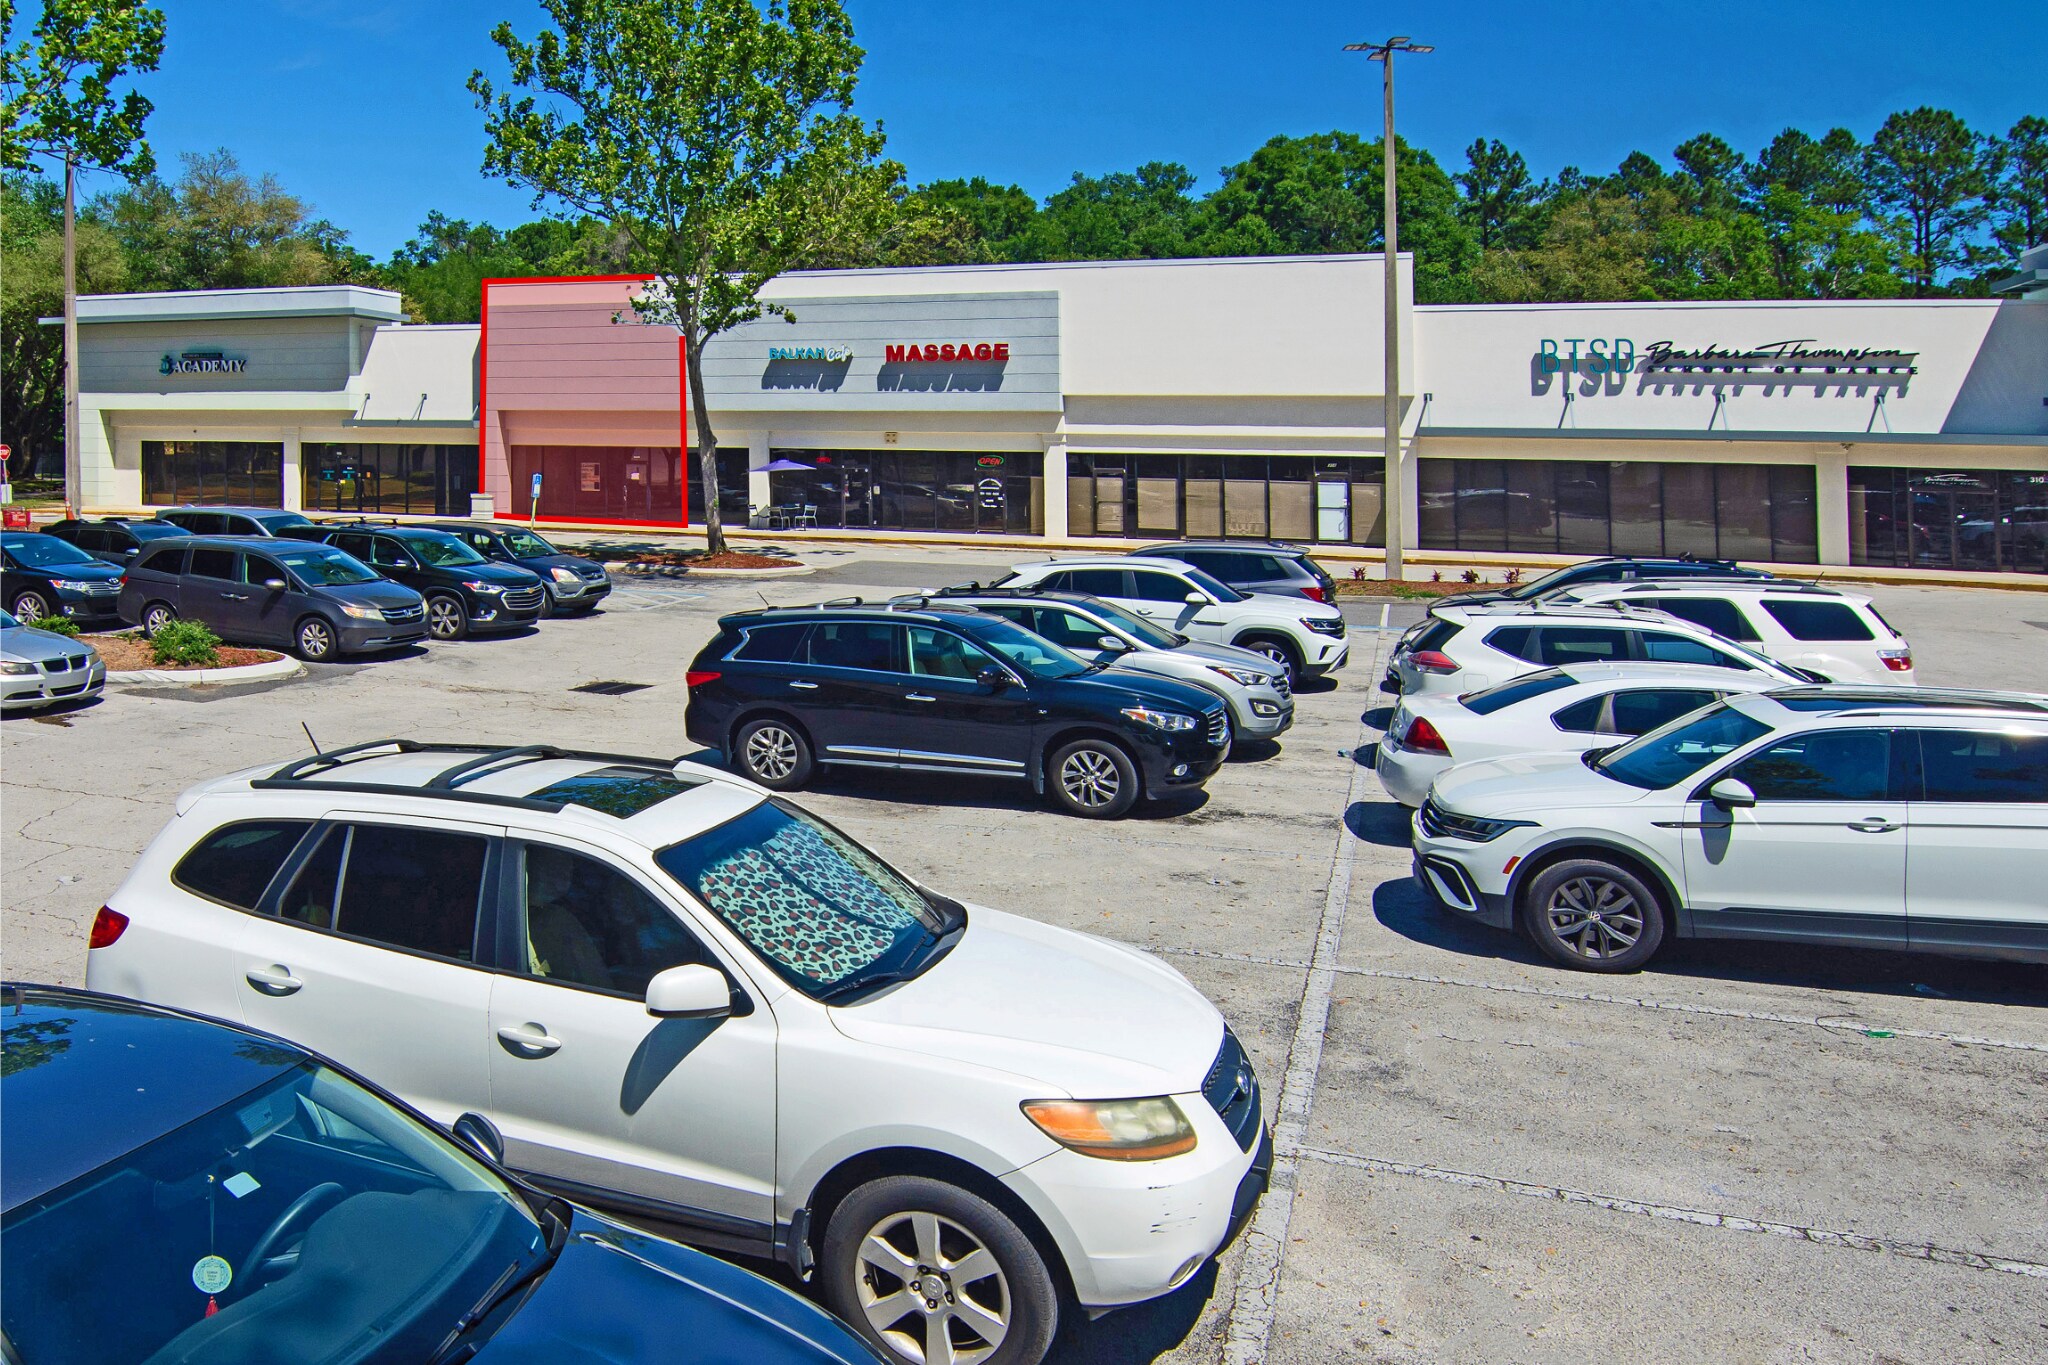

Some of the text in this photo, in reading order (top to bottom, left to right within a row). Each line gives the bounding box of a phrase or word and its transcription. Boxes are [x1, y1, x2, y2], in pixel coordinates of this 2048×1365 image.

[769, 347, 825, 360] BALKAN
[885, 343, 1009, 362] MASSAGE
[1540, 338, 1635, 374] BTSD
[1645, 339, 1920, 364] Barbara Thompson
[173, 360, 246, 373] ACADEMY
[1646, 365, 1752, 374] SCHOOL
[1824, 366, 1919, 375] DANCE
[979, 457, 1001, 465] OPEN
[2030, 476, 2045, 484] 310
